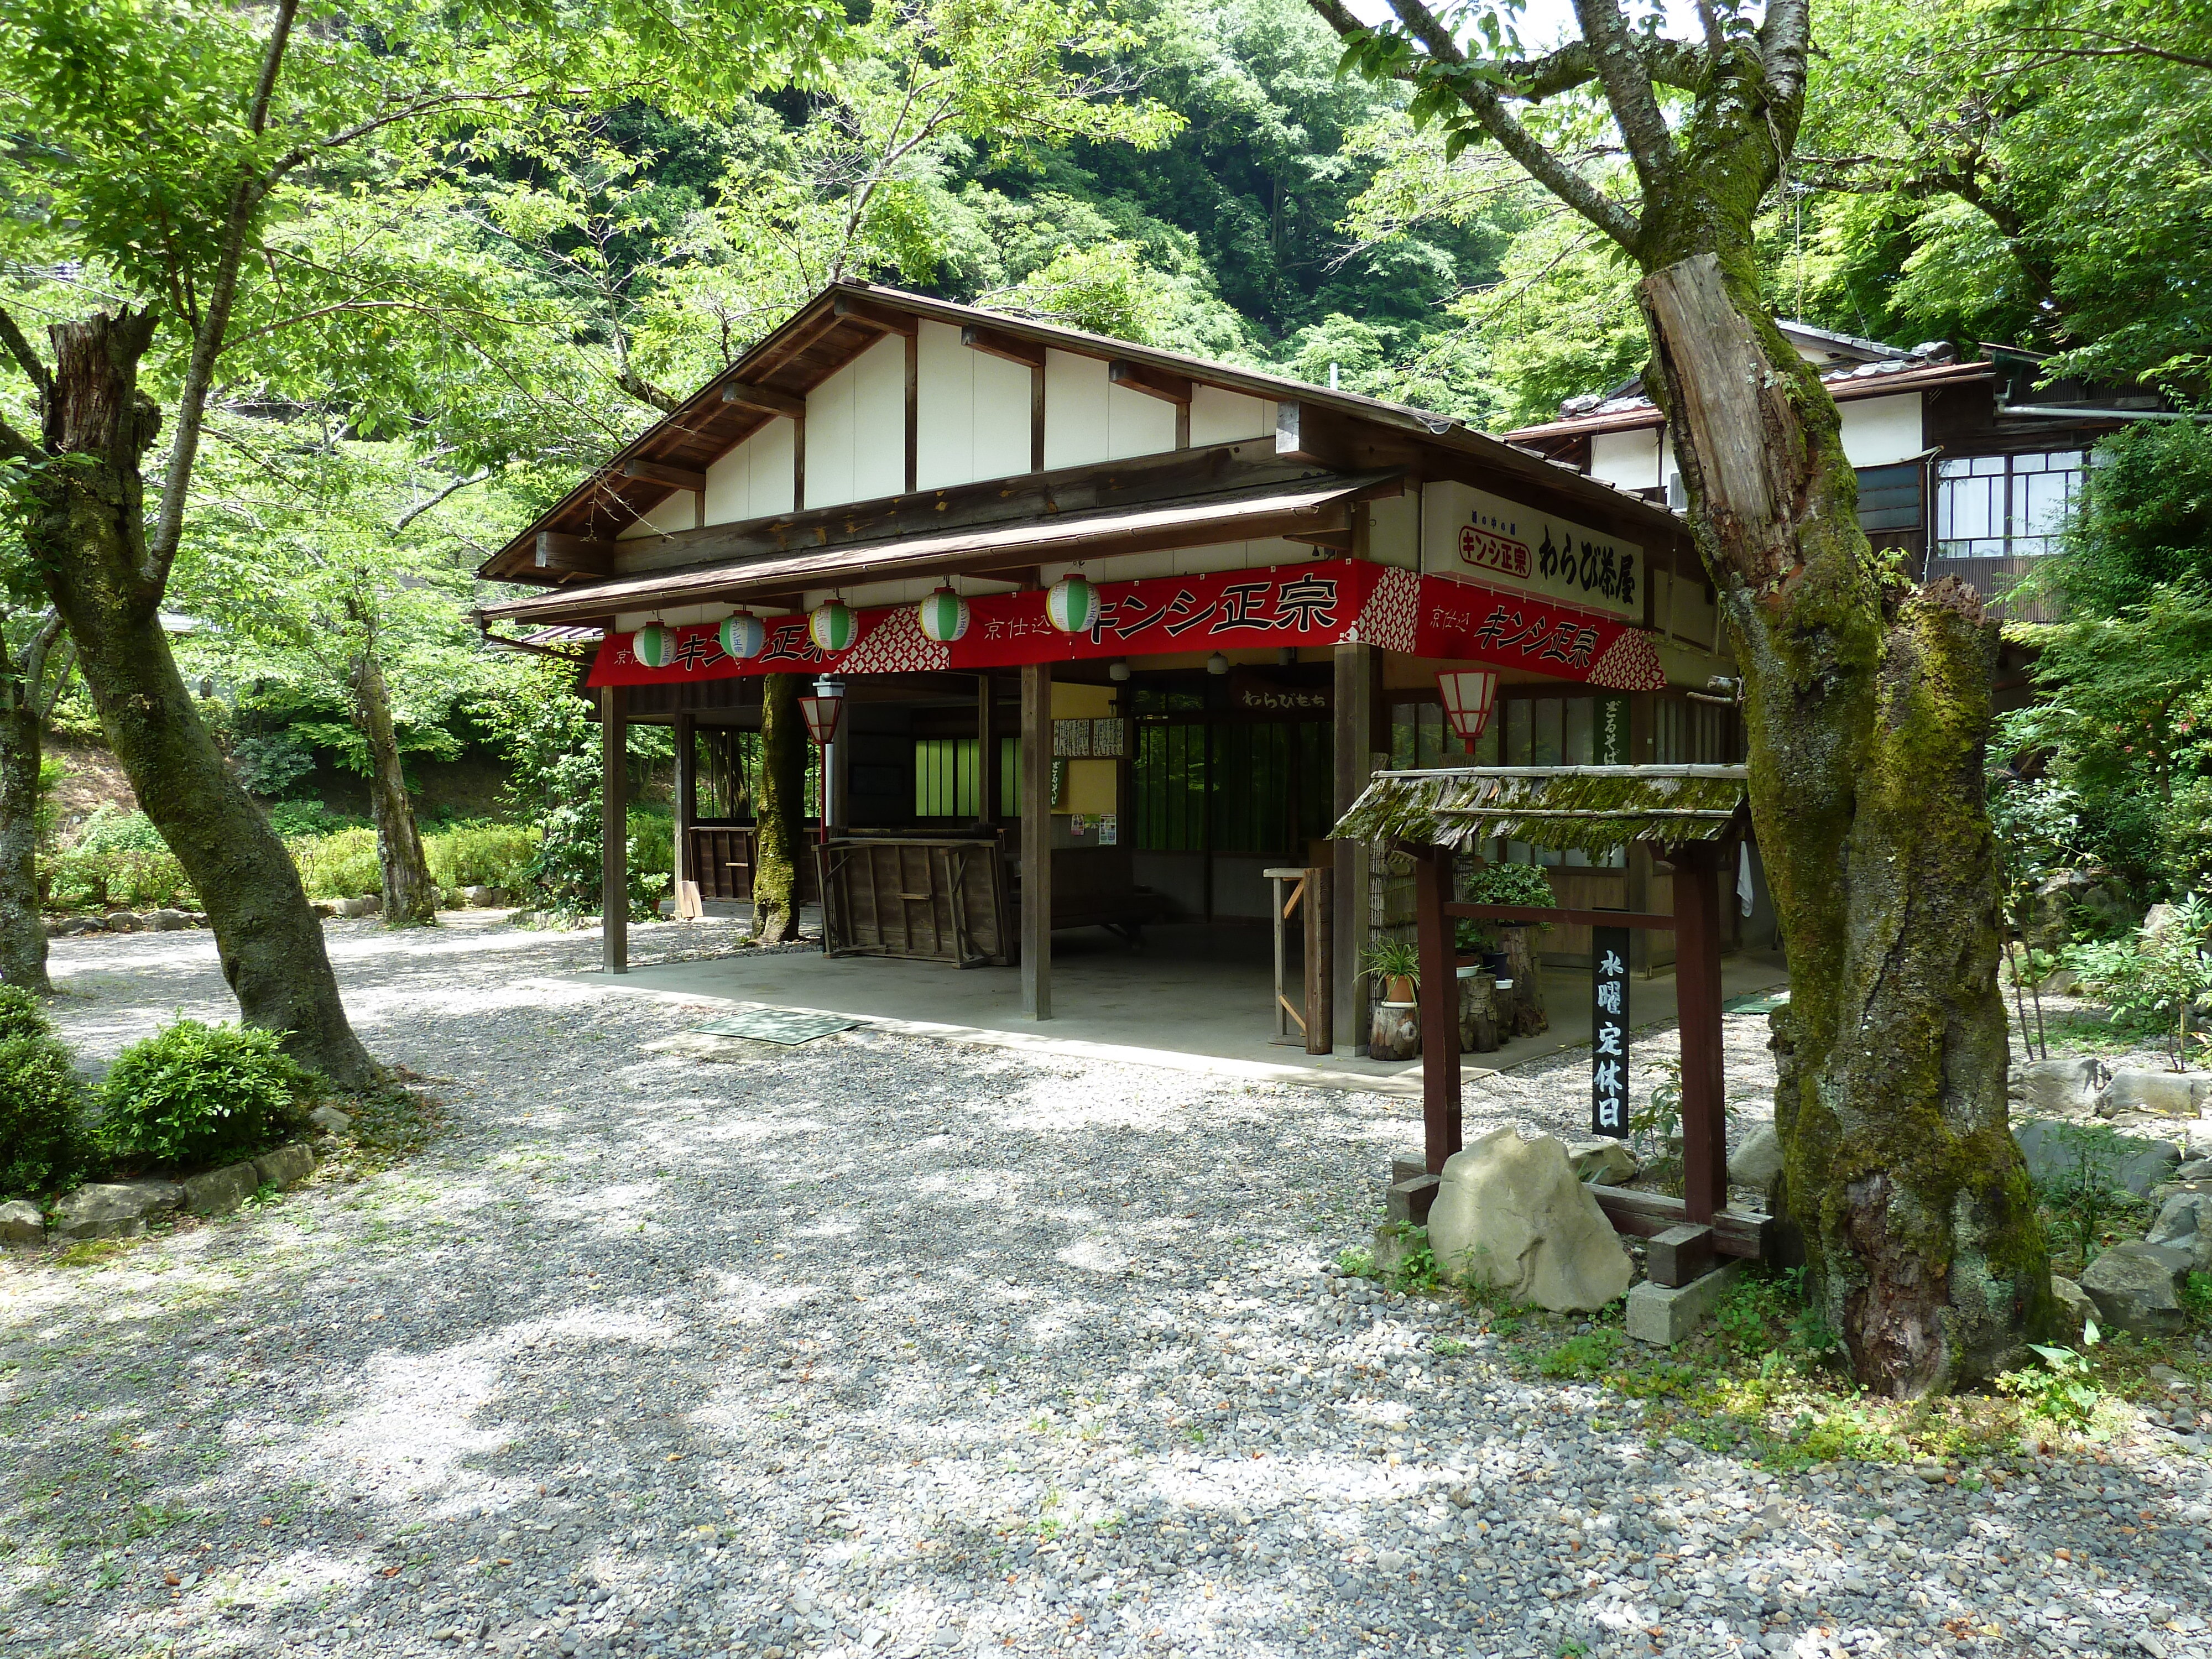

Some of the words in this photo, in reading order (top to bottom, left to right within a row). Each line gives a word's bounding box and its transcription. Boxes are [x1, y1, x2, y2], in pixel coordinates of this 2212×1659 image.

[1462, 530, 1527, 574] キンシ正宗
[1538, 524, 1635, 605] わらび茶屋
[984, 614, 1052, 640] 京仕込
[1428, 604, 1470, 633] 京仕込
[1473, 604, 1600, 669] キンシ正宗
[1242, 690, 1326, 709] わらびもち
[1603, 700, 1621, 765] ざるそば
[1594, 950, 1624, 1128] 水曜定休日
